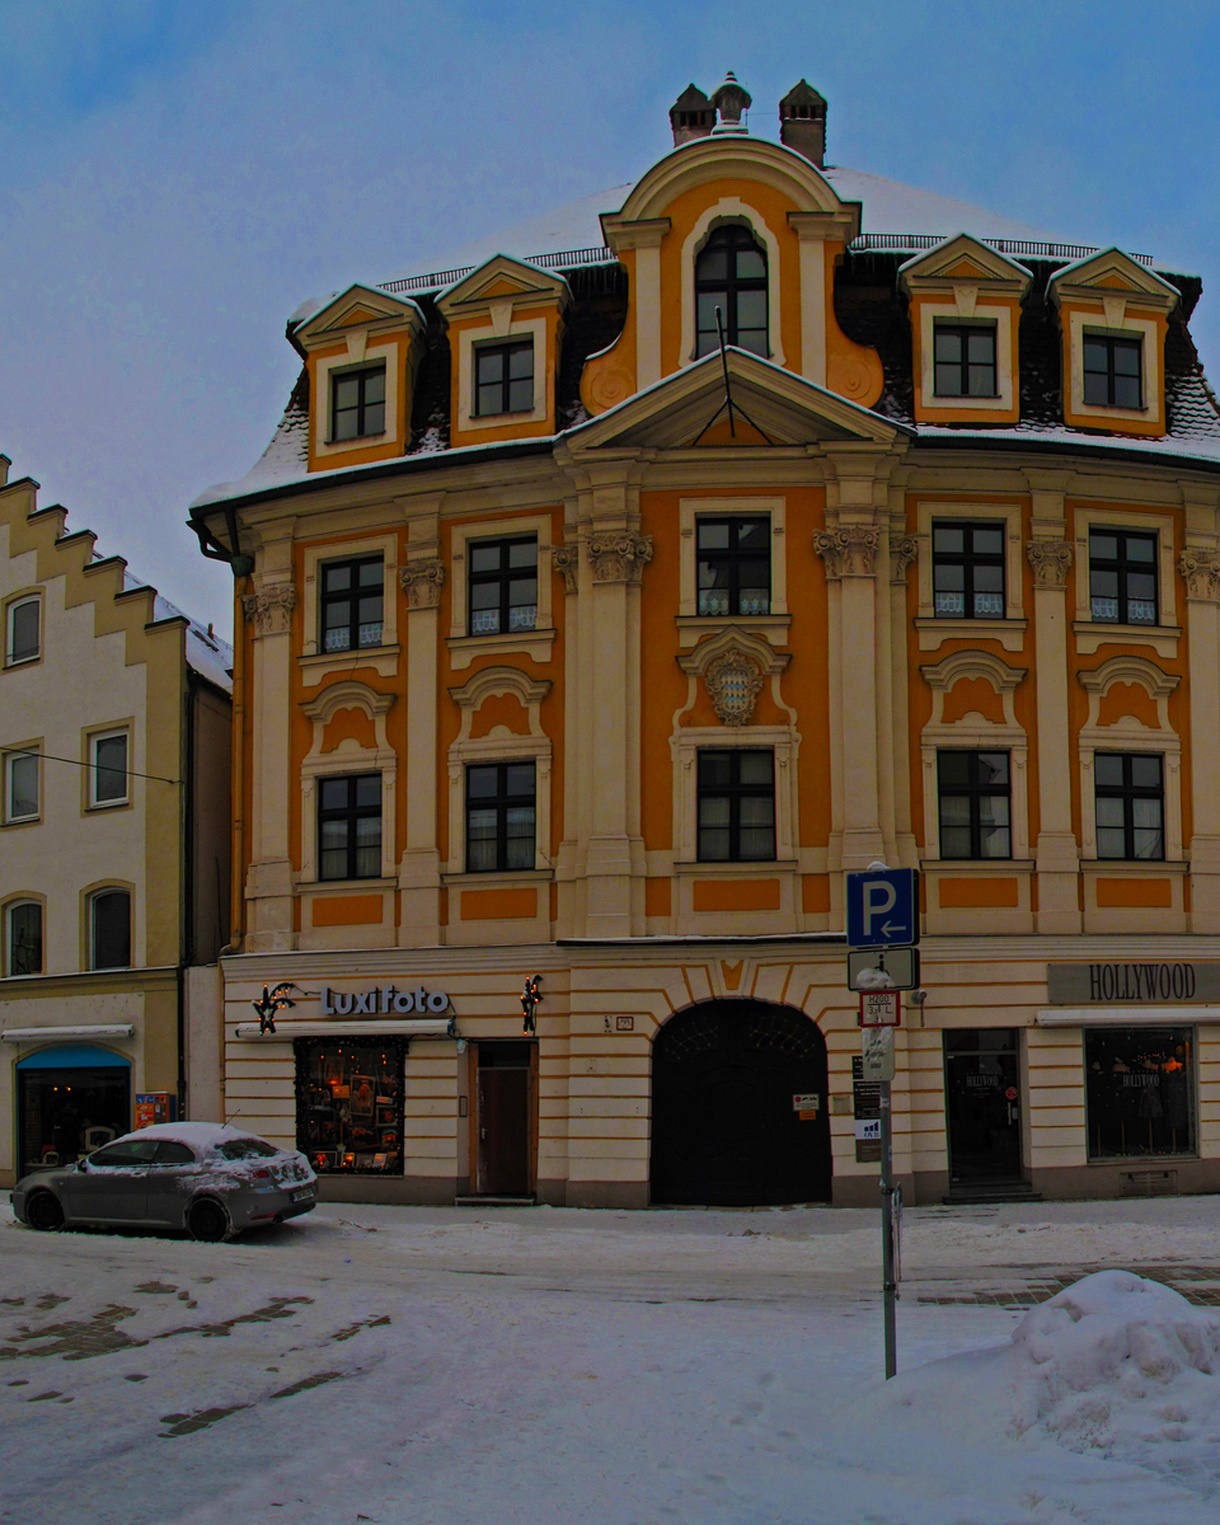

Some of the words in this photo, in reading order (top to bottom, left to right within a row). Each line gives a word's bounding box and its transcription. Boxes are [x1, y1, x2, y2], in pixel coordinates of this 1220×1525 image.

[863, 880, 897, 936] P
[1089, 963, 1196, 1000] HOLLYWOOD
[1122, 1073, 1160, 1088] HOLLYWOOD
